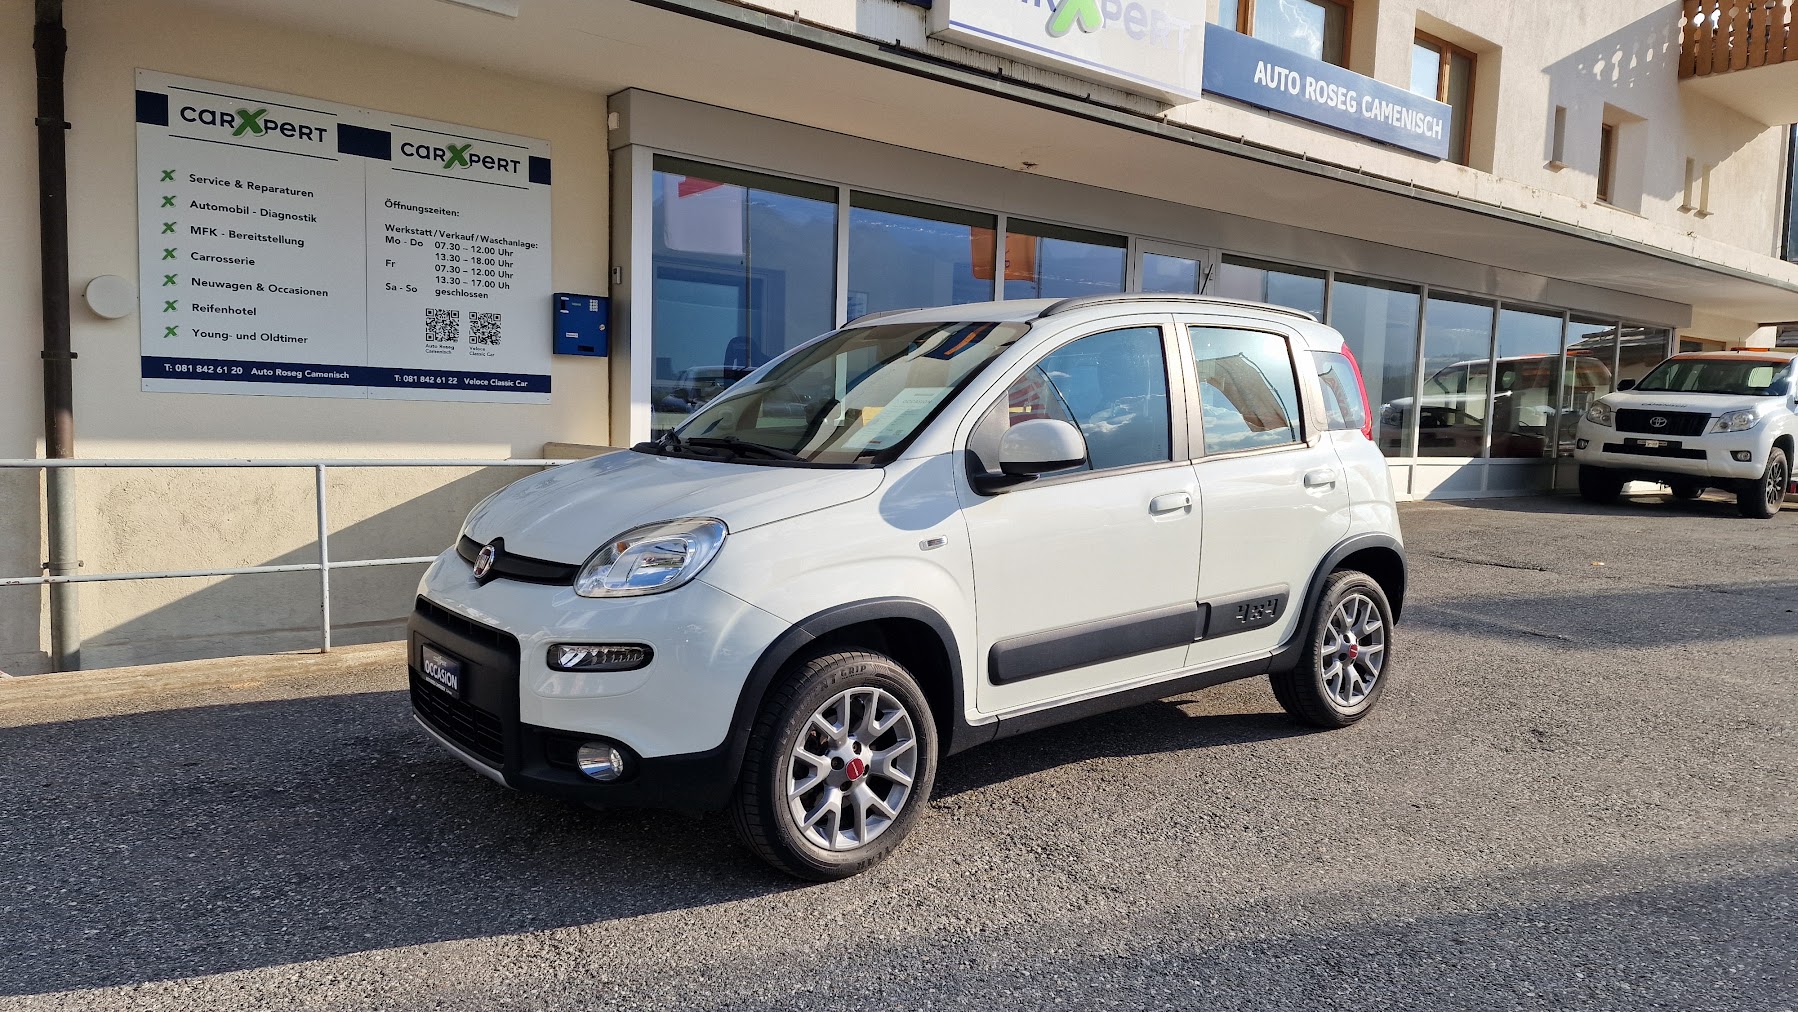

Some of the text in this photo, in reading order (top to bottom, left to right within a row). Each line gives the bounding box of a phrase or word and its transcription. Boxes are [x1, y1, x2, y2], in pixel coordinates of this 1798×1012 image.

[1254, 60, 1443, 140] AUTO ROSEG CAMENISCH
[189, 173, 314, 198] Service & Reparaturen
[189, 199, 249, 215] Automobil
[260, 208, 317, 223] Diagnostik
[384, 198, 460, 217] Öffnungszeiten:
[190, 225, 218, 237] MFK
[228, 230, 305, 248] Bereitstellung
[385, 235, 401, 245] Mo
[410, 238, 424, 247] Do
[434, 241, 461, 251] 07.30
[471, 245, 495, 255] 12.00
[498, 248, 514, 257] Uhr
[190, 252, 256, 266] Carrosserie
[435, 252, 461, 263] 13.30
[471, 257, 495, 267] 18.00
[498, 259, 514, 268] Uhr
[385, 259, 396, 268] Fr
[434, 264, 461, 274] 07.30
[471, 268, 495, 277] 12.00
[498, 270, 514, 279] Uhr
[191, 277, 329, 297] Neuwagen & Occasionen
[385, 282, 397, 291] Sa
[405, 284, 418, 293] So
[434, 289, 489, 299] geschlossen
[435, 275, 461, 285] 13.30
[471, 279, 495, 289] 17.00
[498, 281, 510, 290] Uh
[192, 303, 257, 316] Reifenhotel
[192, 328, 308, 344] Young- und Oldtimer
[164, 363, 349, 379] T: 081 842 61 20 Auto Roseg Camenisch
[394, 374, 402, 382] T:
[403, 374, 418, 383] 081
[420, 375, 435, 383] 842
[436, 376, 446, 384] 61
[463, 377, 489, 386] Veloce
[490, 378, 514, 387] Classic
[515, 379, 528, 387] Car
[424, 659, 458, 690] OCCASION
